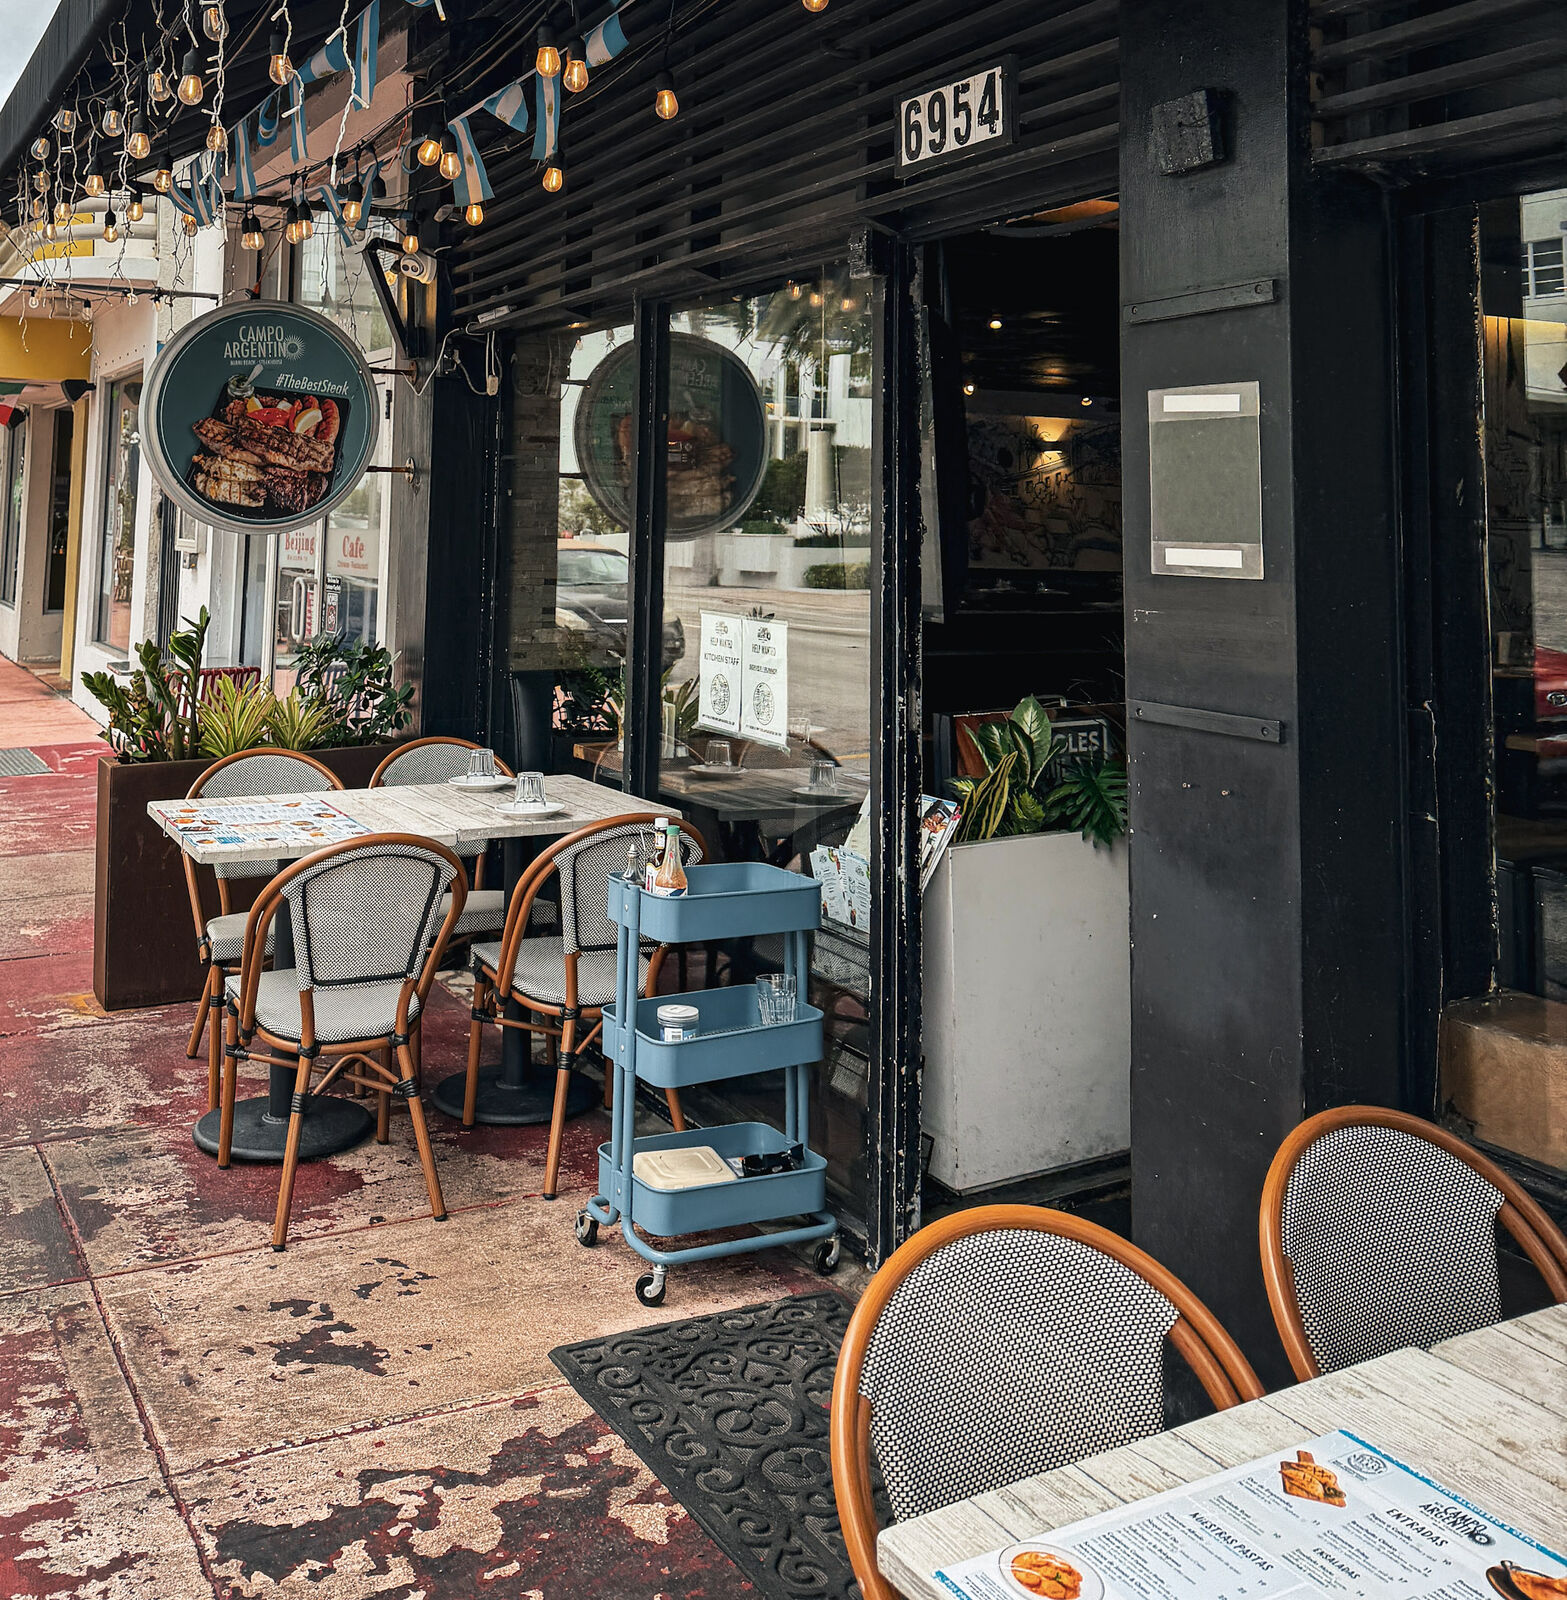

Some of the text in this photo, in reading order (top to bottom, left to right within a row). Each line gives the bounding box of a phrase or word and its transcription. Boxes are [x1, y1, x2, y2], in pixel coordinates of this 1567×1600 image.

[904, 71, 1000, 161] 6954
[239, 326, 284, 342] CAMPO
[275, 373, 350, 396] #TheBestSteak
[285, 532, 315, 556] Beijing
[342, 535, 365, 559] Cafe
[704, 652, 740, 666] KITCHEN STAFF
[1386, 1508, 1449, 1548] ENTRADAS
[1443, 1505, 1488, 1533] CAMPO
[1189, 1511, 1238, 1549] NUESTRAS
[1233, 1543, 1274, 1572] PASTAS
[1311, 1547, 1362, 1579] ENSALADAS
